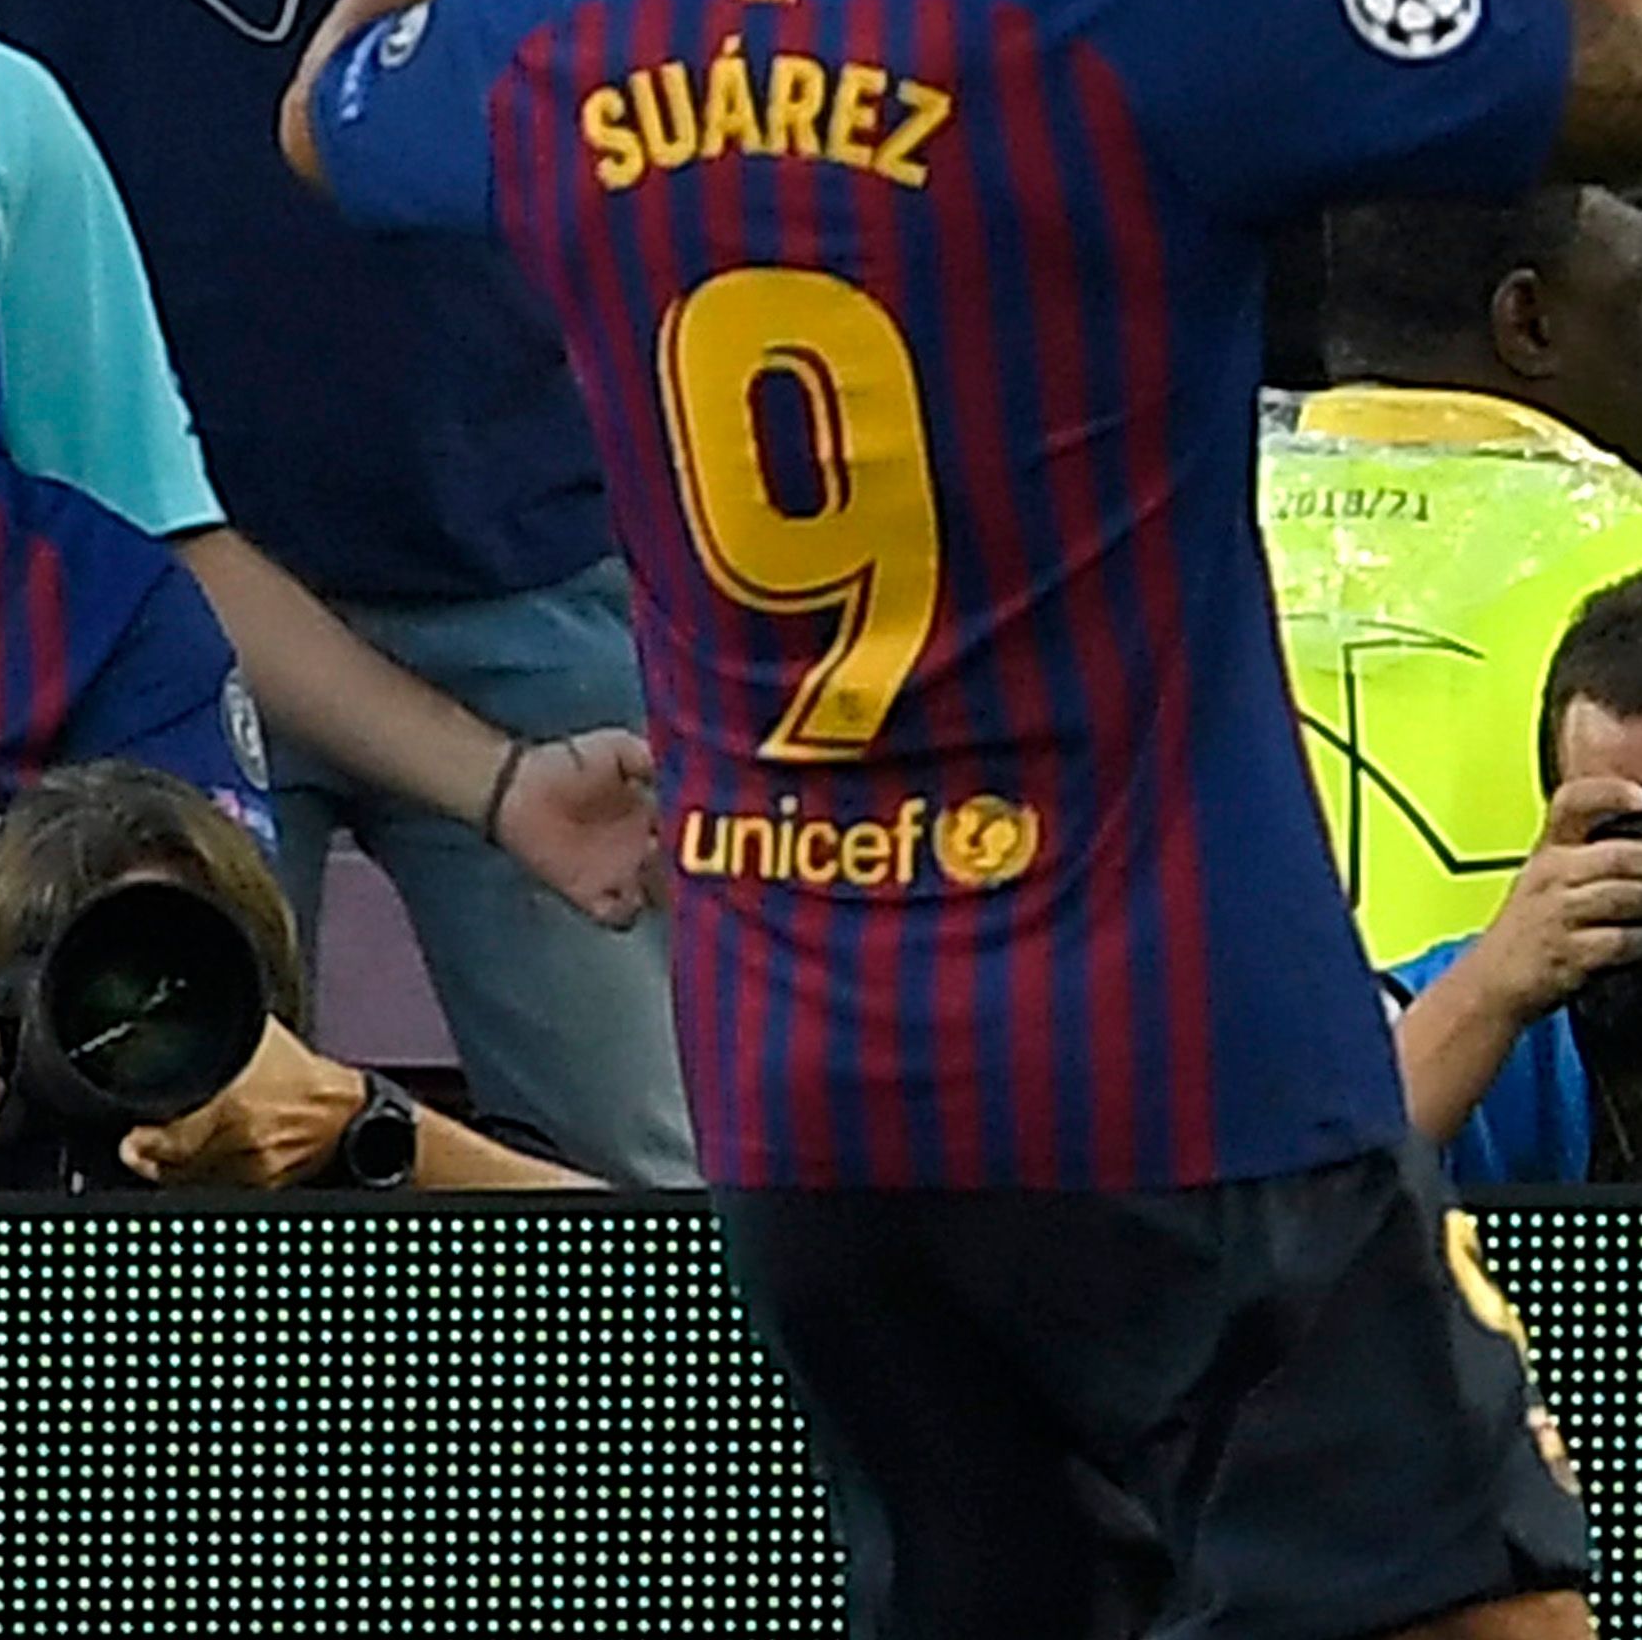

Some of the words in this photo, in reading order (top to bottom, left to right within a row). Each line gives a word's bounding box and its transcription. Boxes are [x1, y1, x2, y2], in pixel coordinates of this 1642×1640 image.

[581, 34, 952, 190] SUÁREZ
[657, 267, 939, 760] 9
[680, 794, 927, 885] unicef
